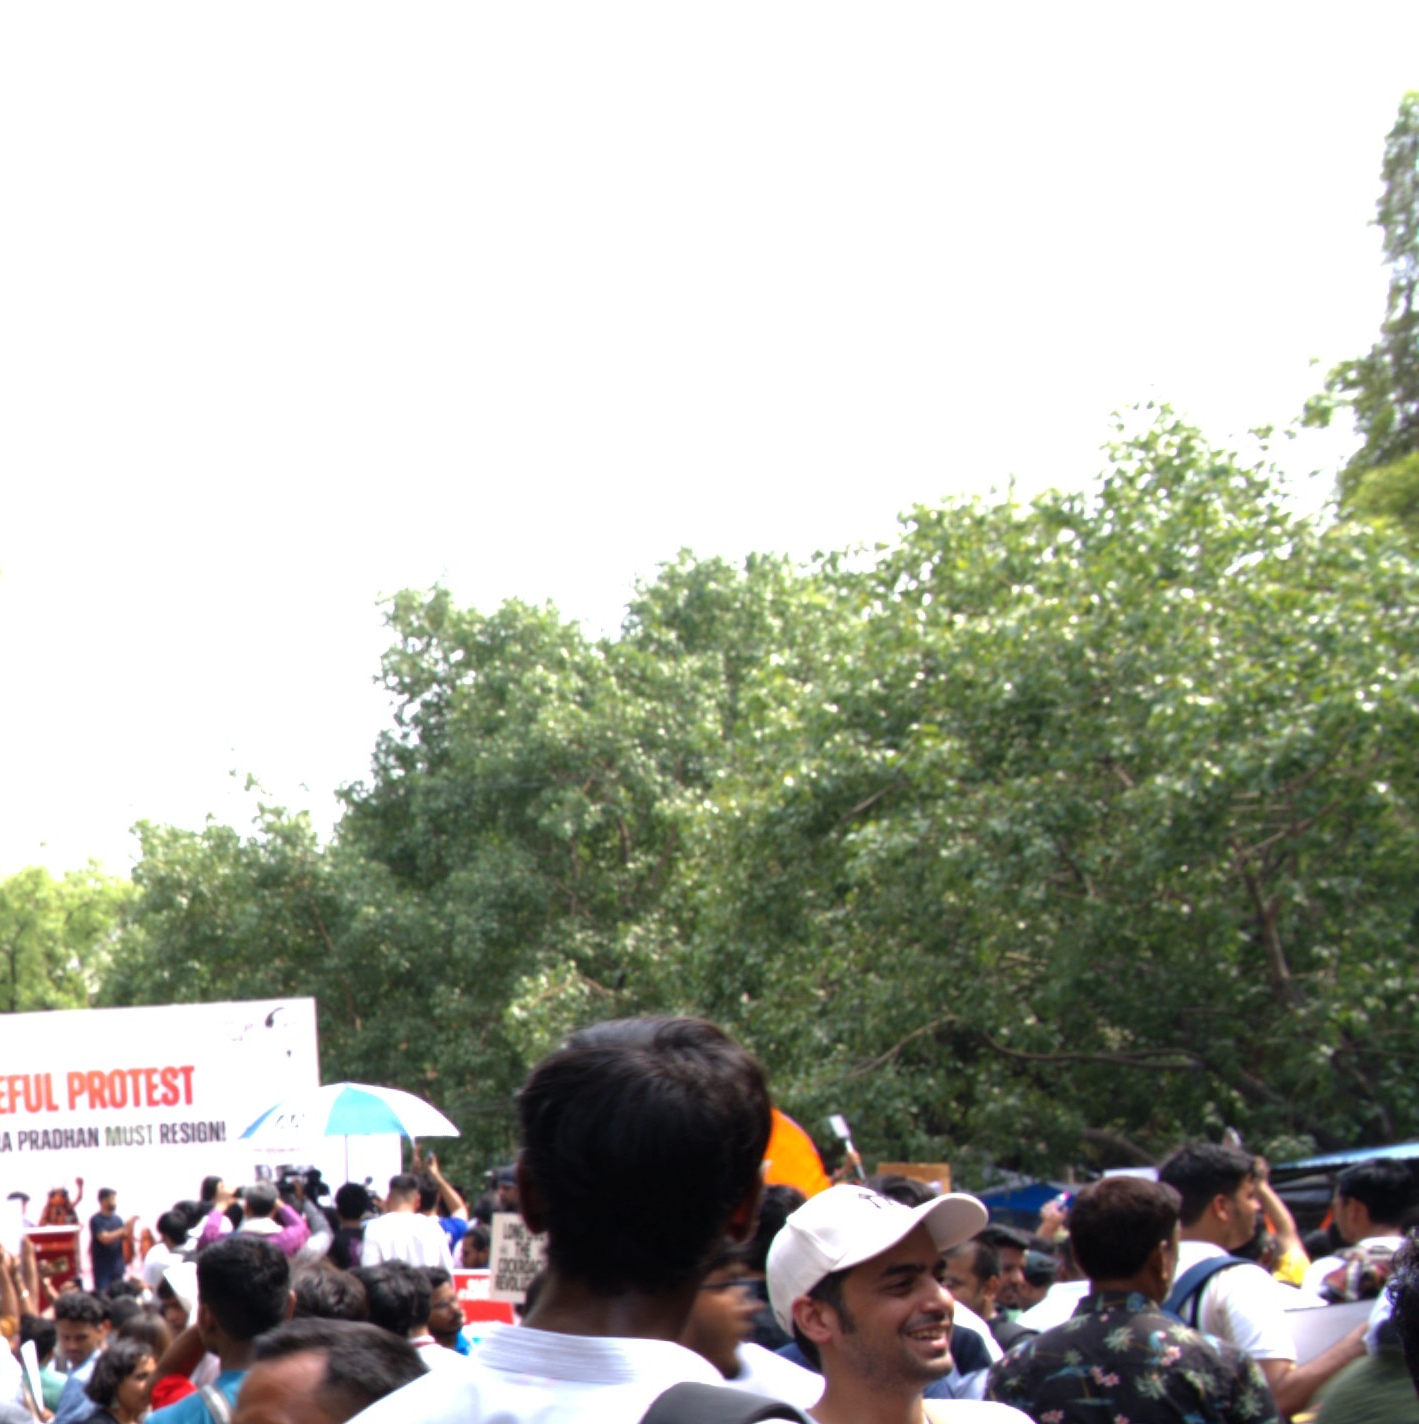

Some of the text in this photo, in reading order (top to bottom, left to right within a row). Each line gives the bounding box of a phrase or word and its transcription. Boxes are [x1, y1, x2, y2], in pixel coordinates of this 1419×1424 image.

[66, 1065, 196, 1111] PROTEST
[18, 1127, 99, 1151] PRADHAN
[105, 1124, 153, 1147] MUST
[160, 1121, 227, 1145] RESIGN!
